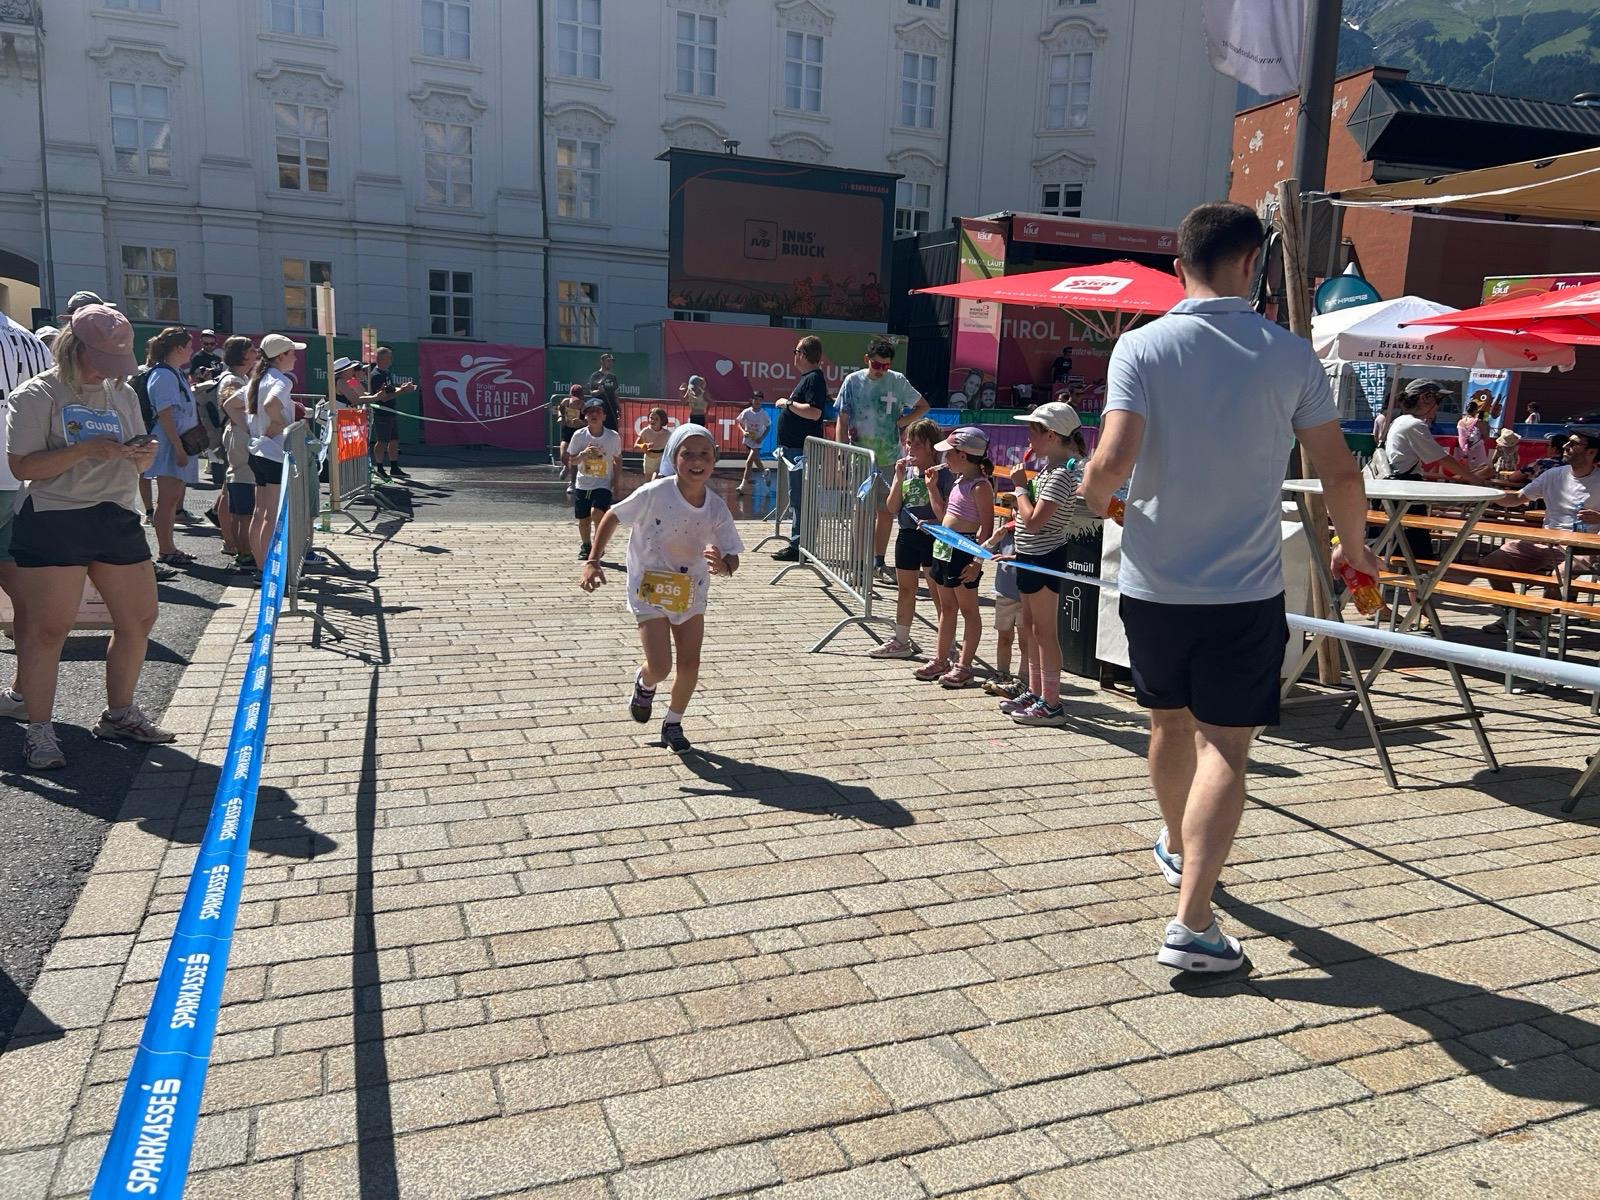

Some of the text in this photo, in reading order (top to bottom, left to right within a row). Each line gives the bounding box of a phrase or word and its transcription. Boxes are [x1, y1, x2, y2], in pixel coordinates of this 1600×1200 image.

[782, 243, 825, 258] BRUCK
[1002, 319, 1061, 341] TIROL
[1379, 340, 1435, 351] Braukunst
[1358, 349, 1376, 358] auf
[1377, 350, 1423, 361] höchster
[740, 361, 797, 380] TIROL
[475, 390, 529, 406] FRAUEN
[475, 405, 510, 418] LAUF
[85, 420, 120, 433] GUIDE
[1066, 560, 1094, 574] stmüll
[655, 583, 681, 597] 836
[219, 803, 241, 842] SPARKASSE
[199, 871, 229, 921] SPARKASSE
[170, 963, 209, 1030] SPARKASSE
[126, 1093, 178, 1195] SPARKASSE
